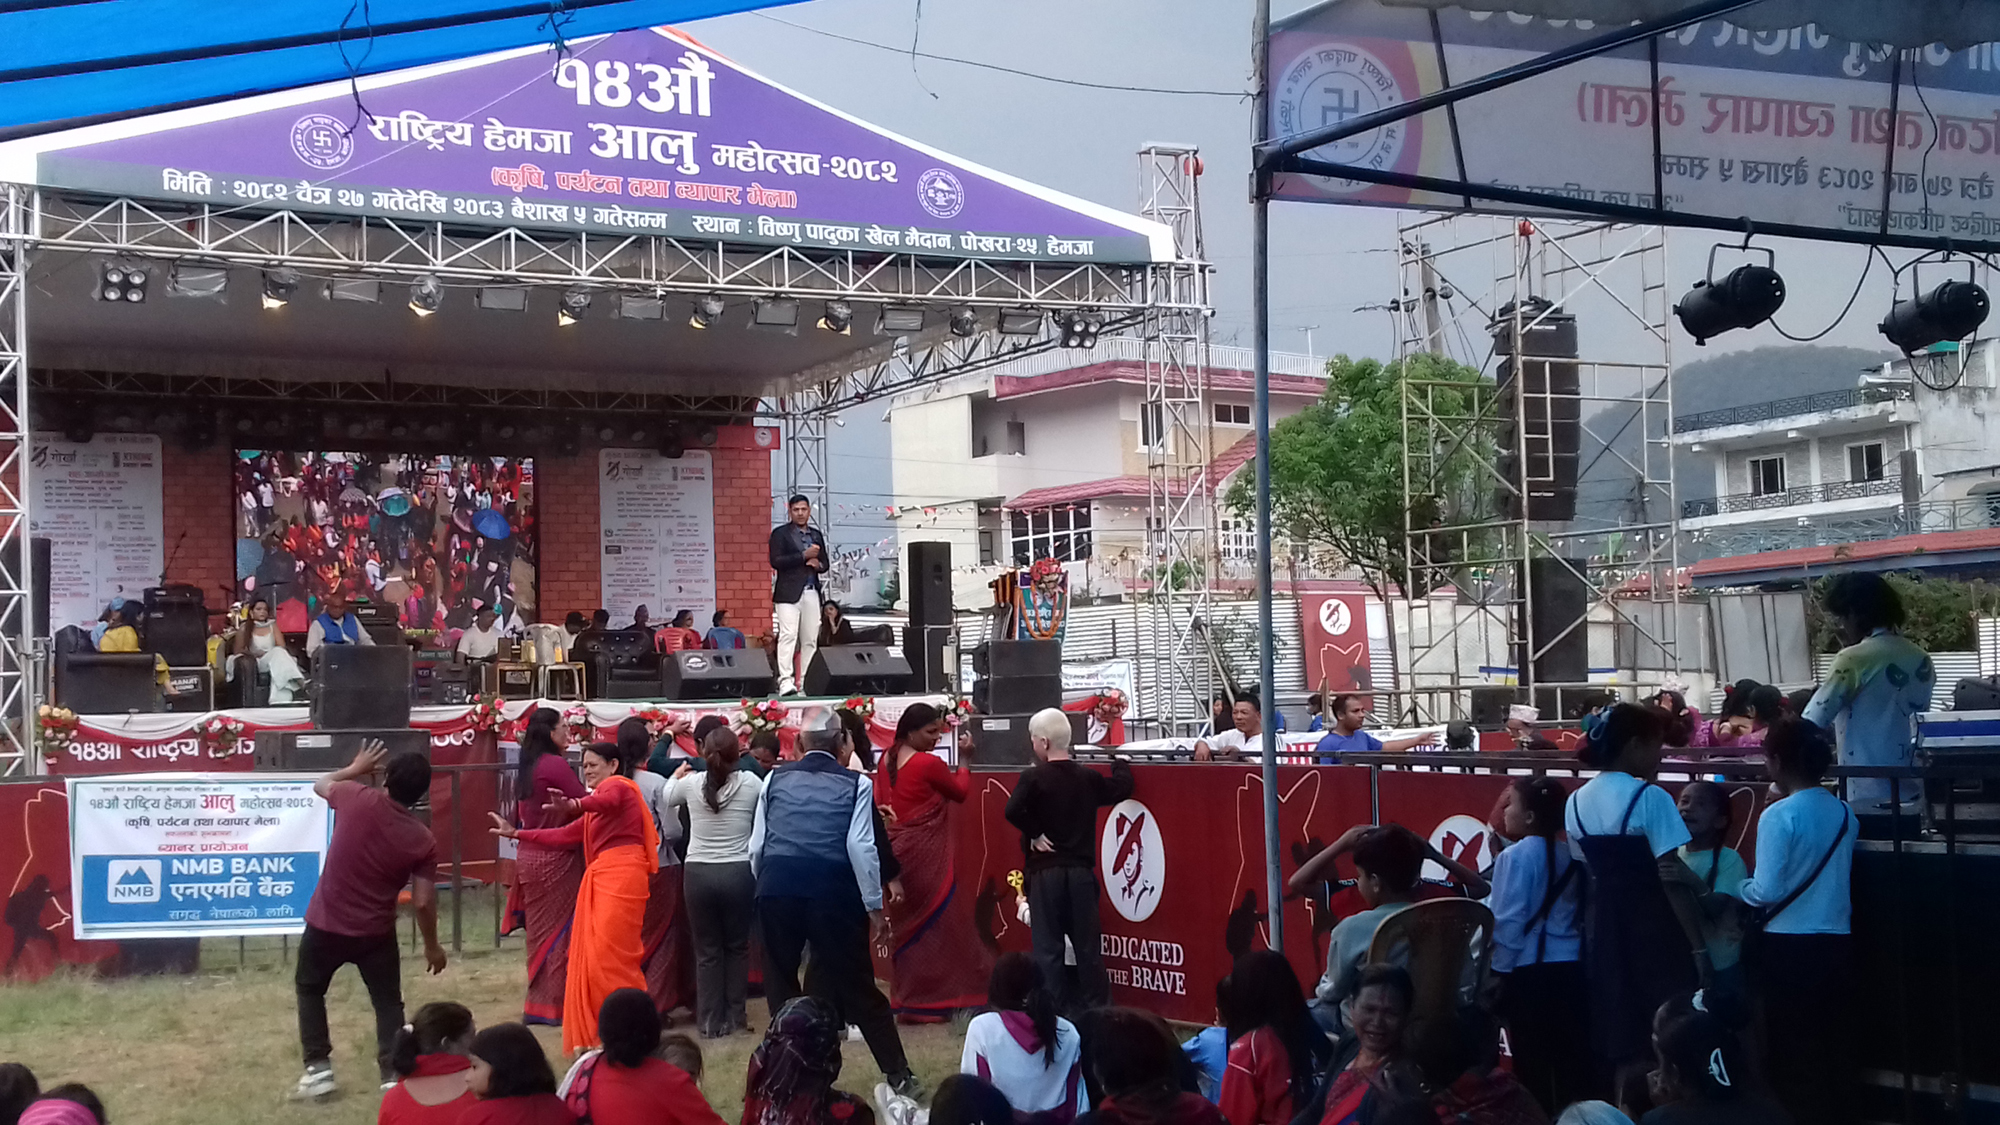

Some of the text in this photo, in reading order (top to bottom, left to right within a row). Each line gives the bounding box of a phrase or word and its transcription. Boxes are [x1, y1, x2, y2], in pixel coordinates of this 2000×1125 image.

[367, 110, 474, 151] राष्ट्रिय
[483, 118, 573, 154] हेमजा
[588, 122, 700, 175] आलु
[711, 141, 898, 183] महोत्सव-२०८२
[555, 168, 622, 195] पर्यटन
[628, 177, 670, 199] तथा
[675, 180, 742, 205] व्यापार
[747, 182, 798, 209] मेला)
[162, 168, 213, 195] मिति
[233, 179, 289, 202] २०८२
[295, 180, 333, 206] चैत्र
[338, 188, 366, 208] २७
[371, 188, 449, 215] गतेदेखि
[453, 197, 505, 220] २०८३
[511, 196, 568, 223] बैशाख
[573, 207, 587, 225] ५
[592, 204, 668, 230] गतेसम्म
[692, 213, 741, 235] स्थान
[757, 215, 802, 243] विष्णु
[805, 221, 860, 246] पादुका
[865, 223, 901, 247] खेल
[904, 226, 956, 251] मैदान,
[1046, 234, 1095, 257] हेमजा
[431, 728, 476, 747] ०८२
[122, 795, 161, 812] राष्ट्रिय
[164, 796, 197, 811] हेमजा
[199, 793, 237, 814] आलु
[240, 794, 314, 810] महोत्सव-२०८२
[157, 815, 190, 828] पर्यटन
[193, 817, 214, 828] तथा
[217, 816, 251, 828] व्यापार
[254, 814, 281, 828] मेला)
[200, 841, 249, 853] प्रायोजन
[171, 856, 296, 876] NMB BANK
[113, 884, 155, 898] NMB
[168, 874, 295, 902] एनएमबि बैंक
[209, 905, 258, 920] नेपालको
[265, 904, 294, 918] लागि
[1100, 933, 1185, 966] EDICATED
[1106, 965, 1187, 996] THE BRAVE
